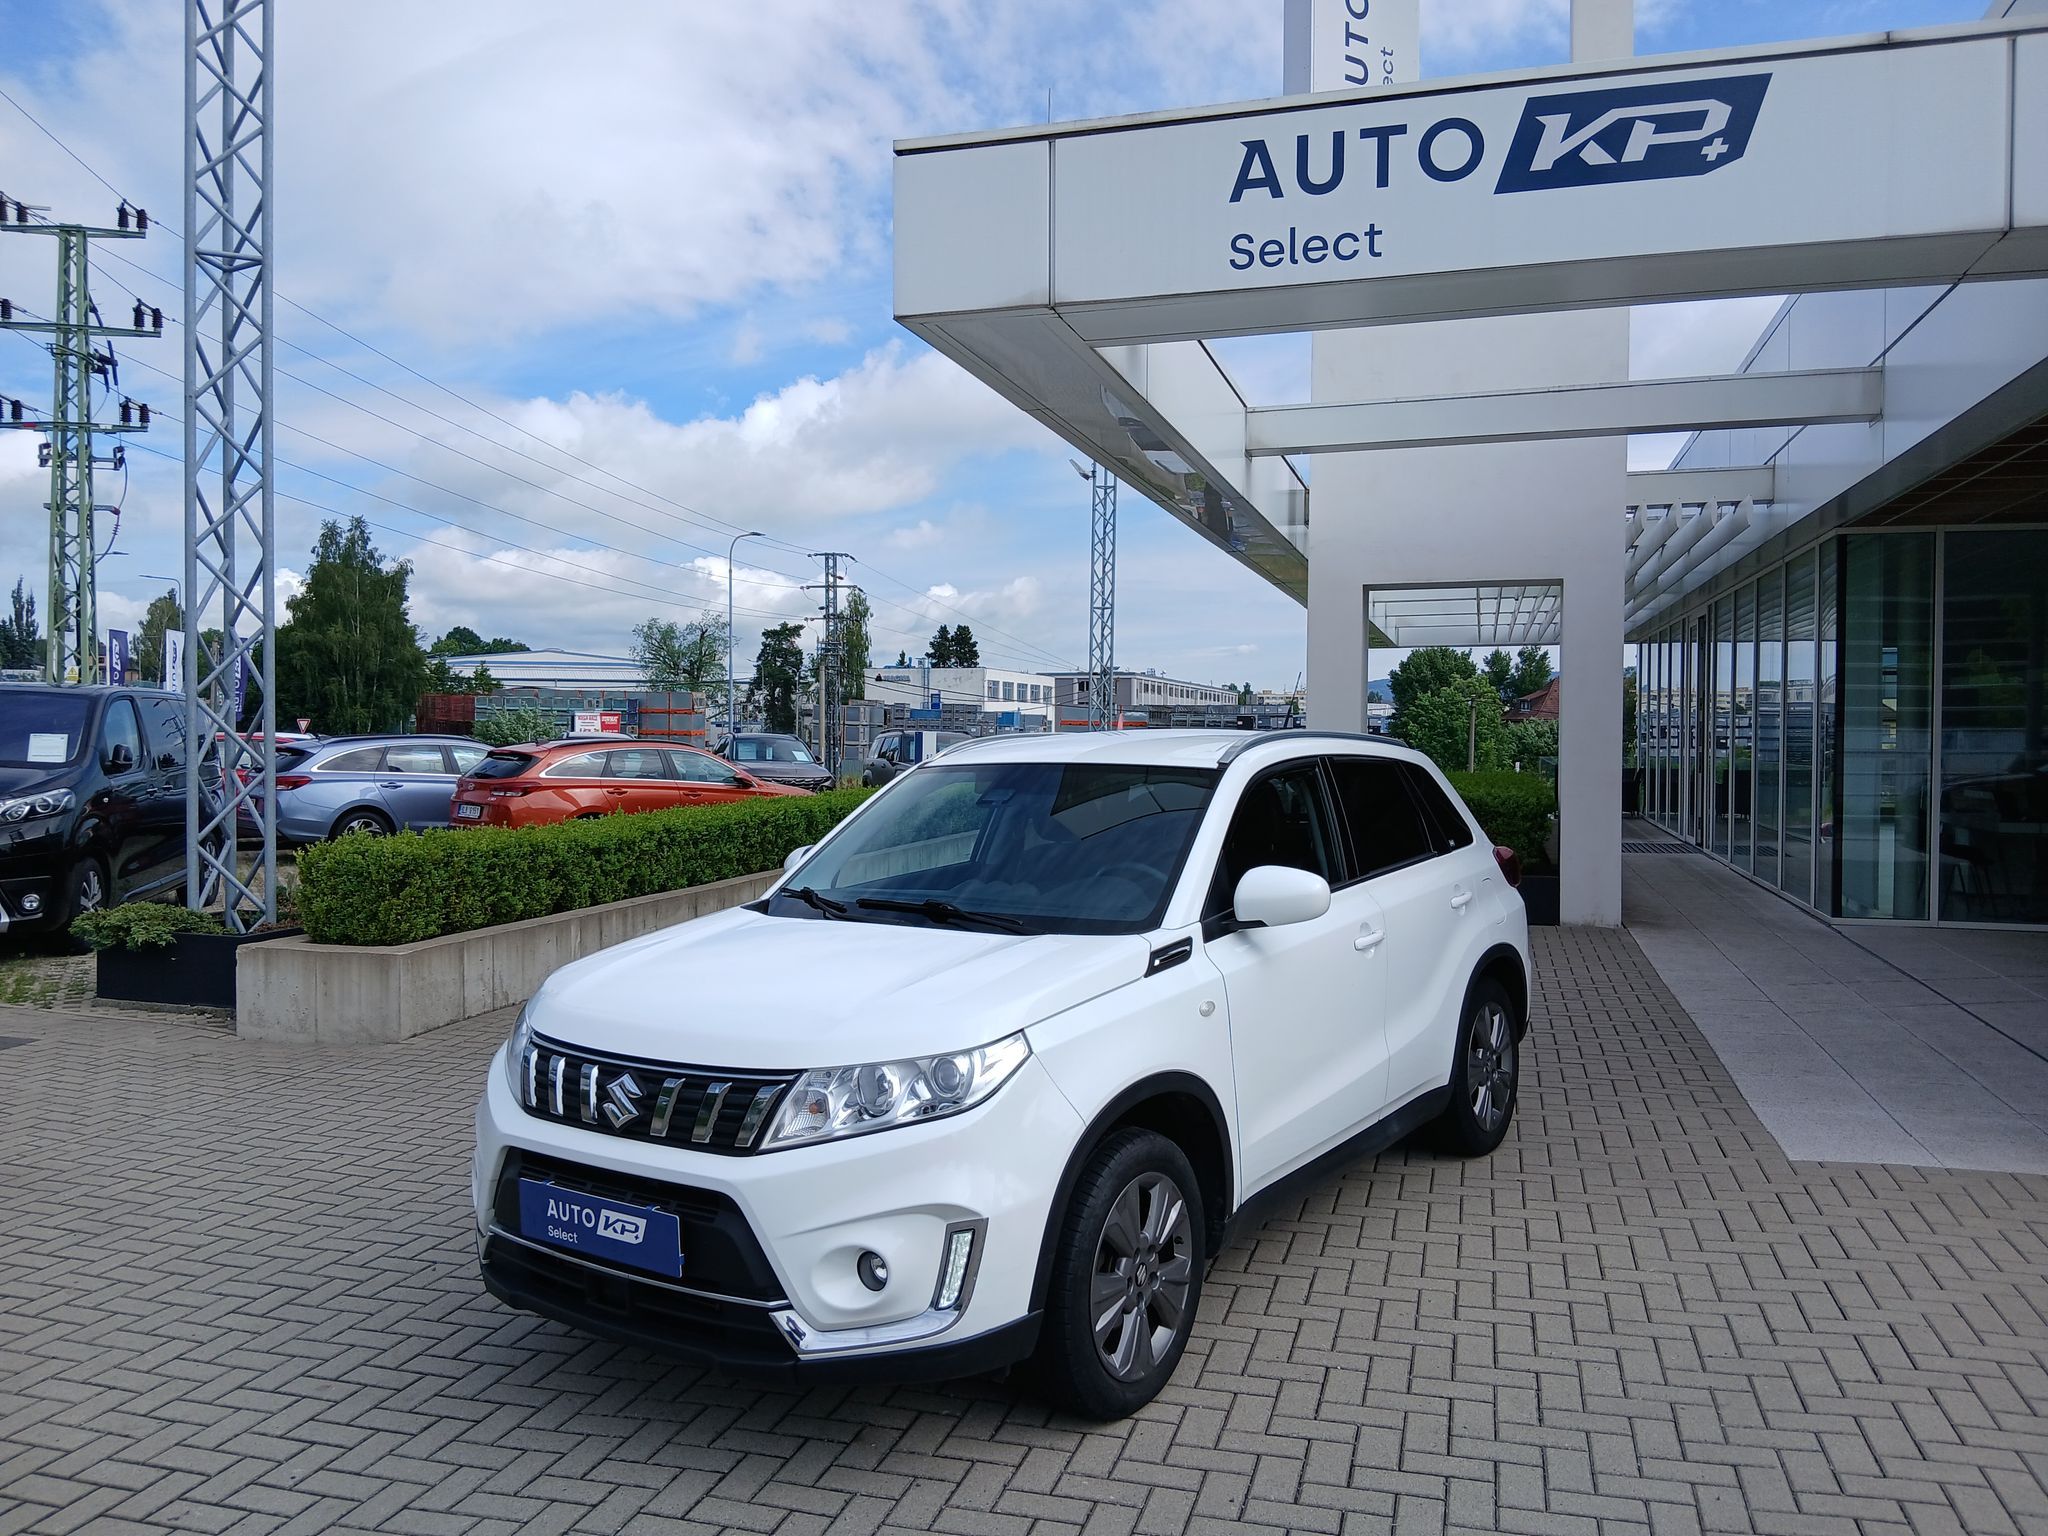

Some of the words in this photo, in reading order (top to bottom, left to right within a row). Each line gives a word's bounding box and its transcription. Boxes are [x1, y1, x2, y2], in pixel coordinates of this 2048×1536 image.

[1228, 116, 1486, 204] AUTO
[1228, 222, 1383, 271] Select
[546, 1198, 596, 1228] AUTO
[547, 1224, 579, 1244] Select
